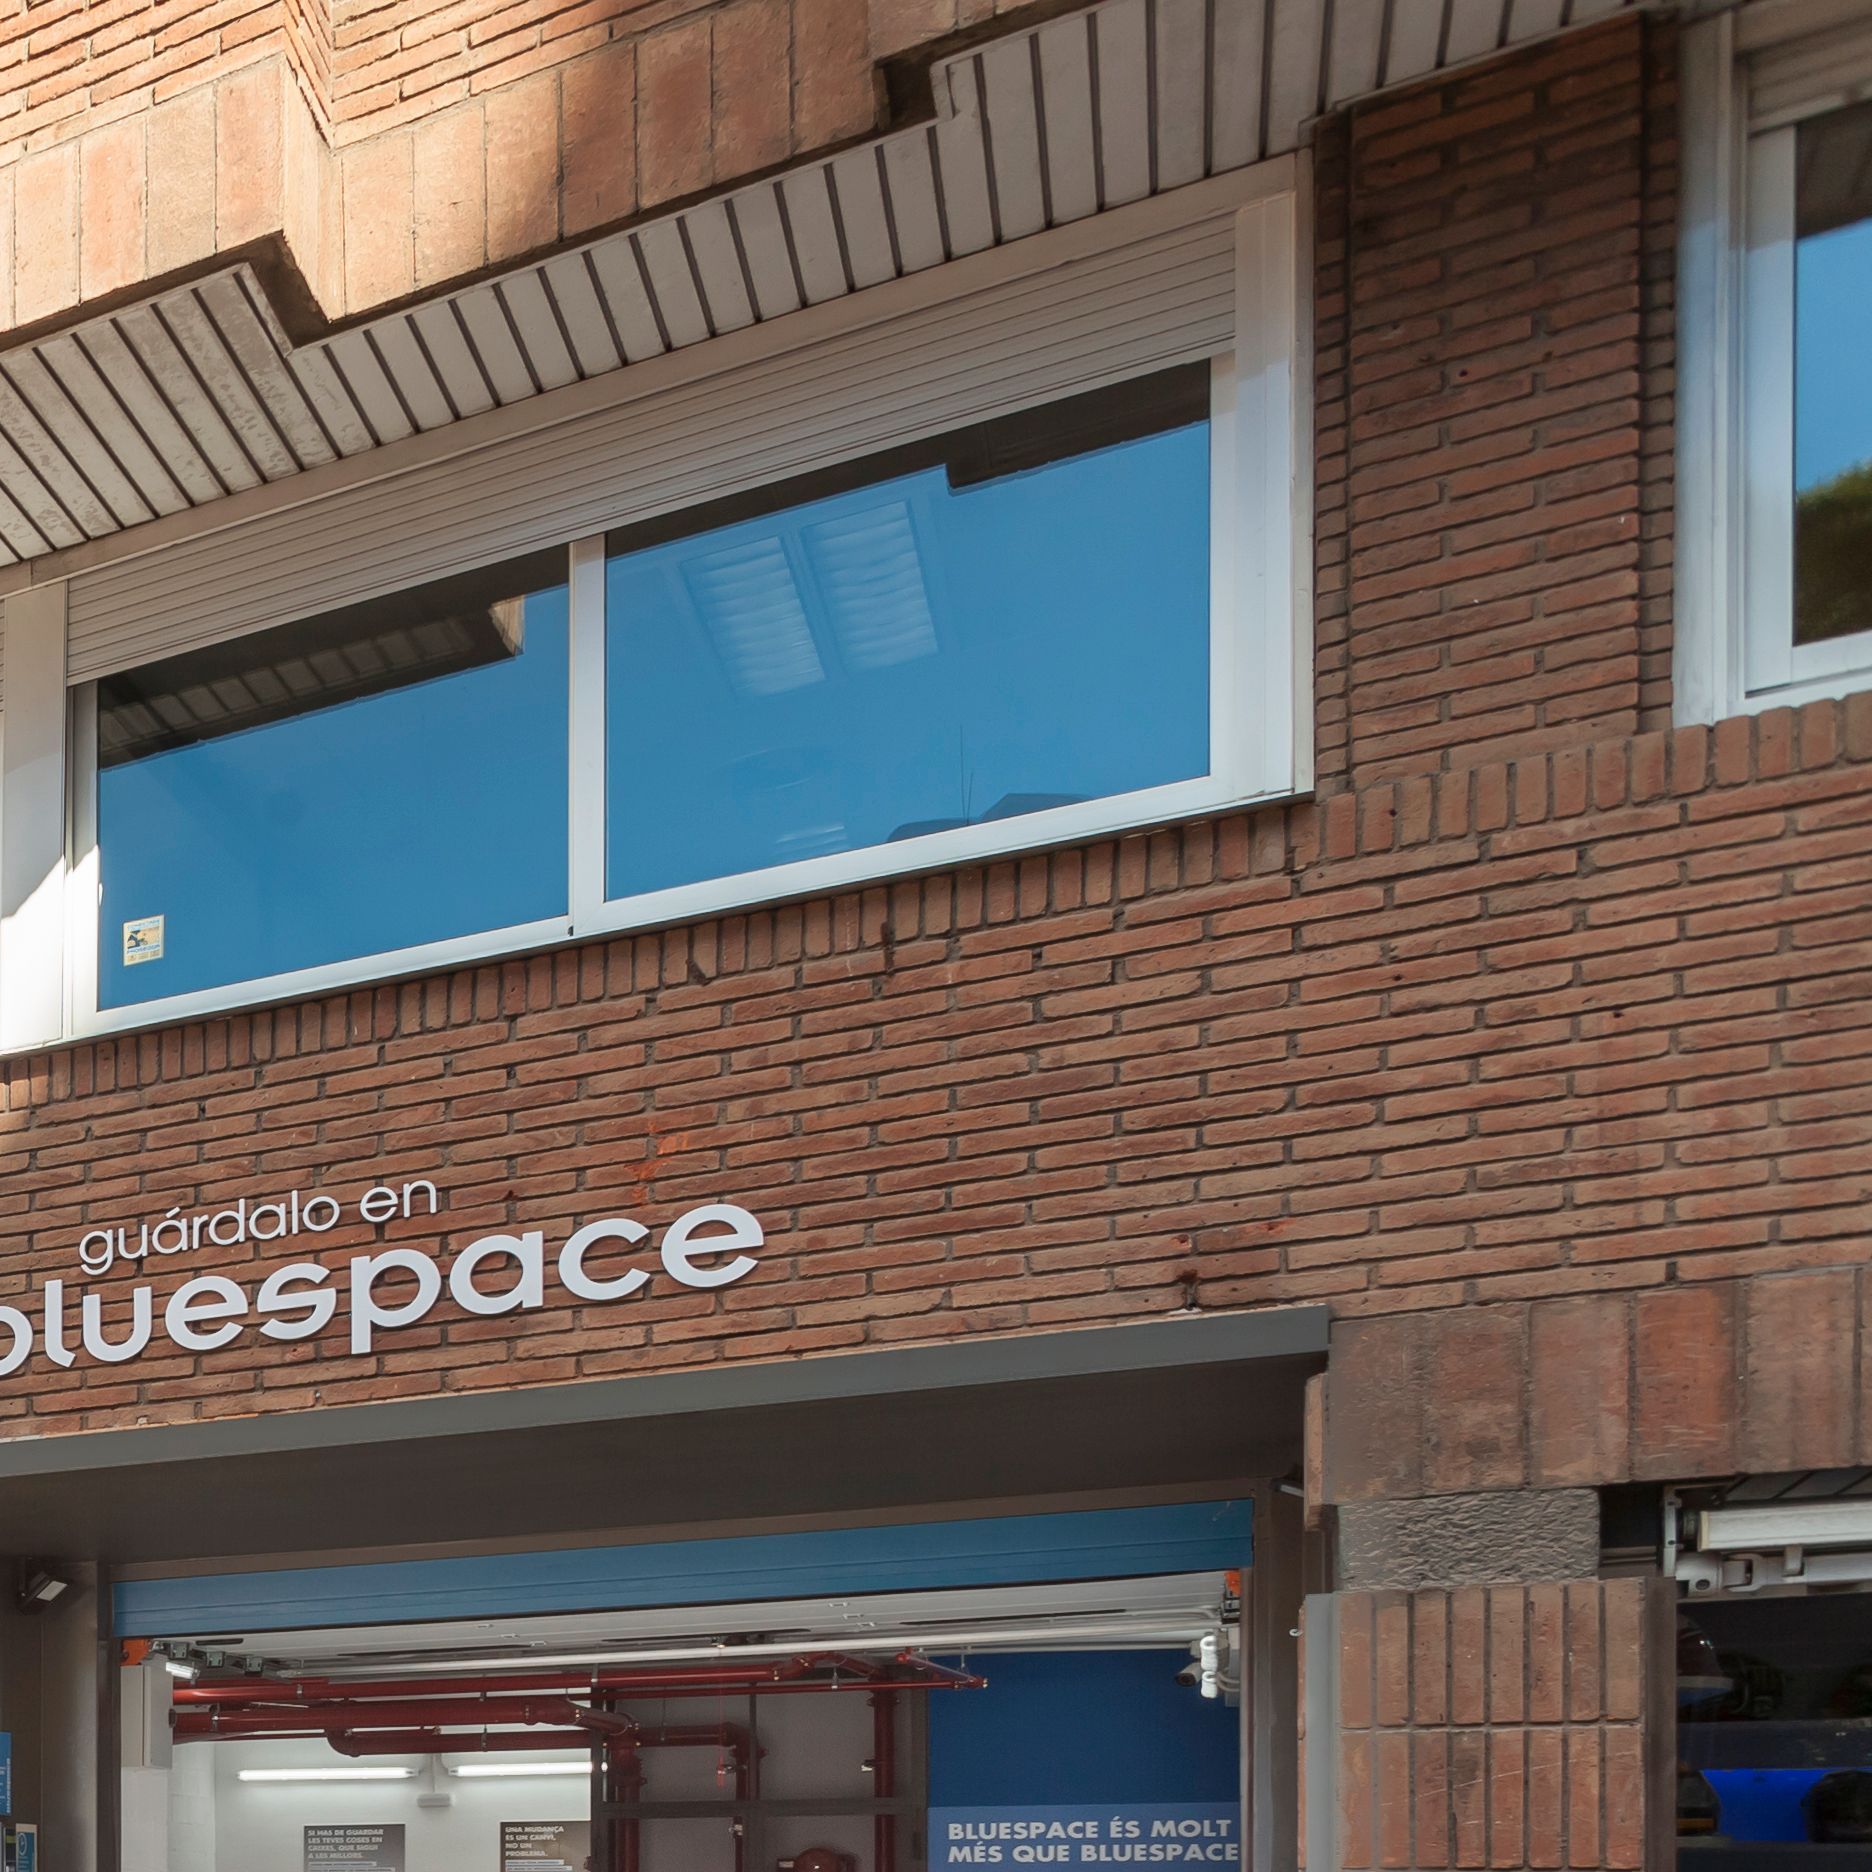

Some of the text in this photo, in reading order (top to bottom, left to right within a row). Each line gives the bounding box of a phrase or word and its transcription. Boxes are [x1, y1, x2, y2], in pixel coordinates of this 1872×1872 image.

[79, 1179, 438, 1276] guárdalo en
[947, 1816, 1232, 1840] BLUESPACE ÉS MOLT
[948, 1841, 1240, 1864] MÉS QUE BLUESPACE
